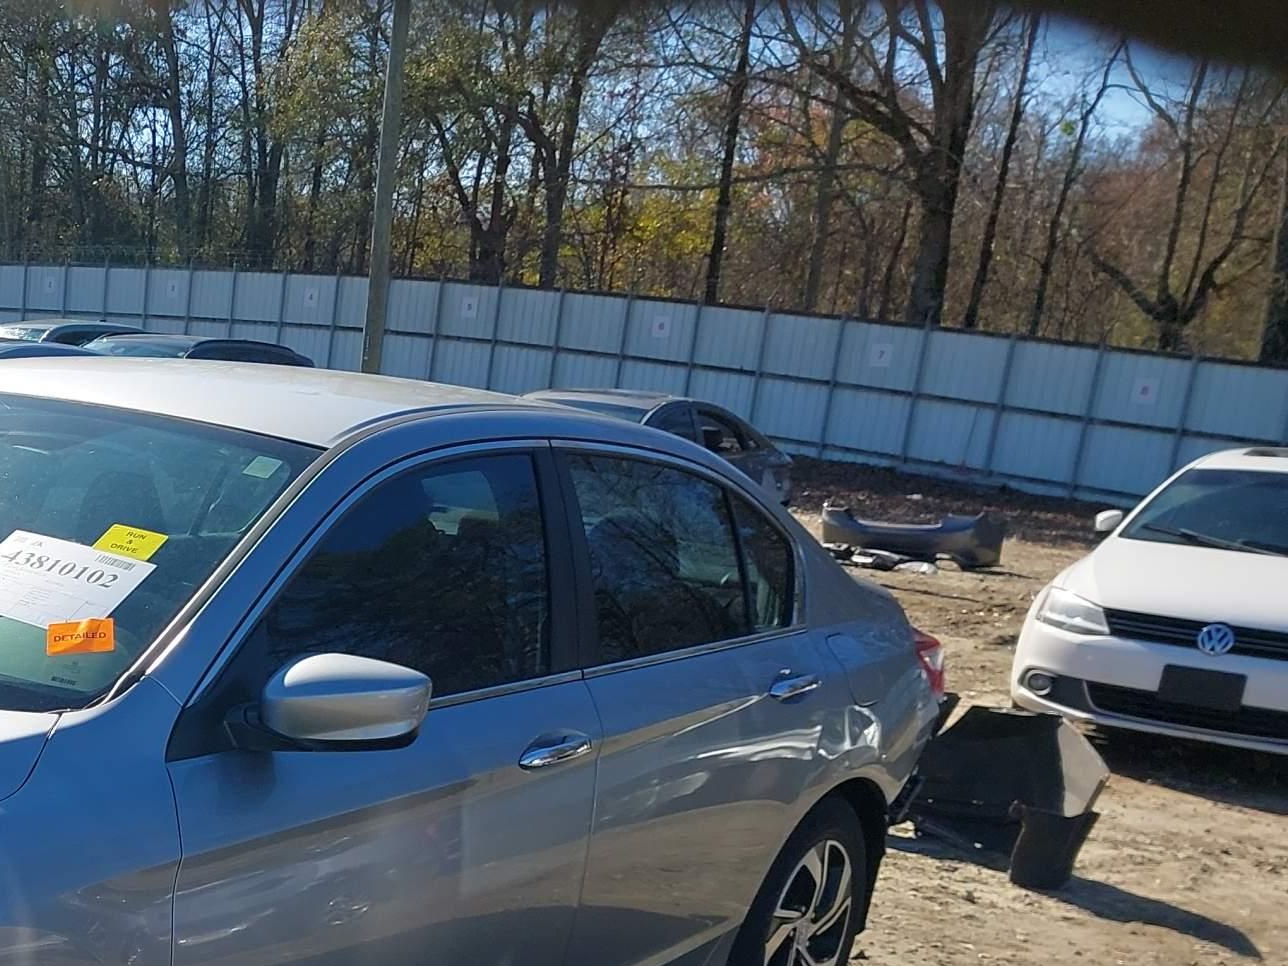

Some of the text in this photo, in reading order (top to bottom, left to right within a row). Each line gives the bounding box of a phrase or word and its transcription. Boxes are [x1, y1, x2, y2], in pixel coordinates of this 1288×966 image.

[125, 531, 148, 540] RUN
[110, 543, 139, 554] DRIVE
[1, 550, 119, 588] 43810102
[53, 631, 107, 643] DETAILED
